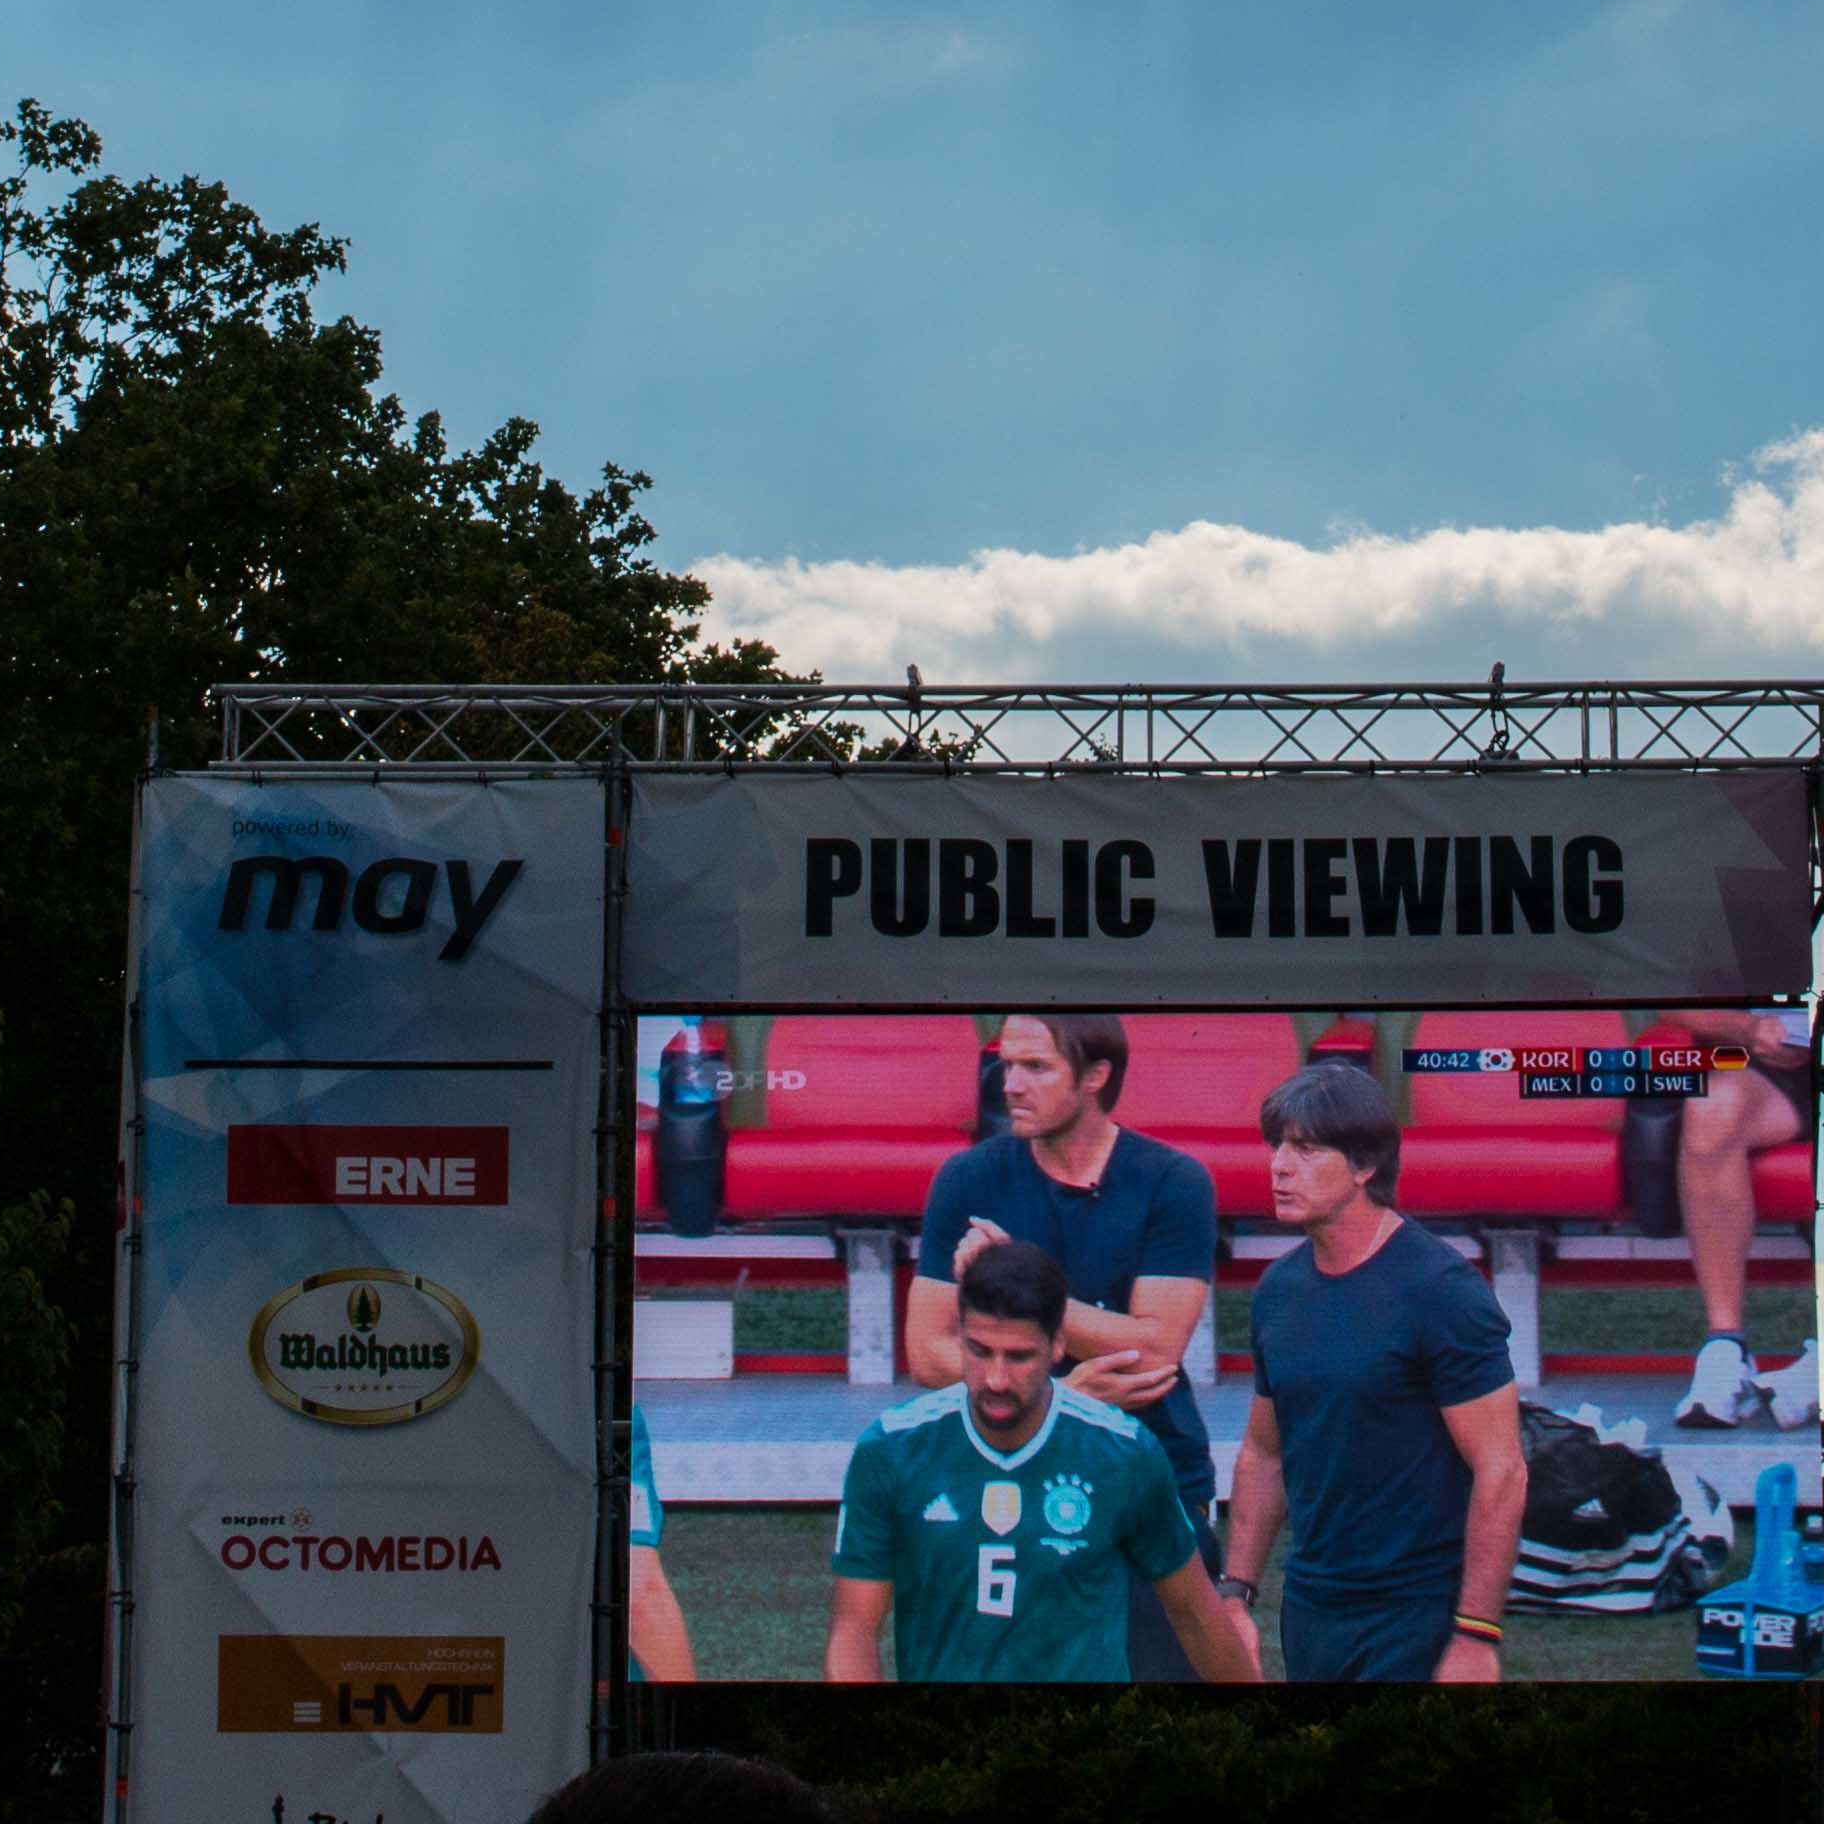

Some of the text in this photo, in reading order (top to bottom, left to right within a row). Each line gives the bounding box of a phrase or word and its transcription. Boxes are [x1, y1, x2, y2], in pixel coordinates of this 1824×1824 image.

[232, 817, 352, 841] powered by
[804, 834, 1624, 939] PUBLIC VIEWING
[217, 855, 526, 962] may
[1417, 1050, 1702, 1069] 40:42 KOR 0 0 GER
[1532, 1076, 1693, 1092] MEX 0 0 SWE
[335, 1157, 476, 1197] ERNE
[279, 1332, 451, 1377] Waldhaus
[221, 1512, 286, 1528] expert
[220, 1535, 502, 1572] OCTOMEDIA
[977, 1544, 1017, 1617] 6
[338, 1683, 494, 1725] HVT
